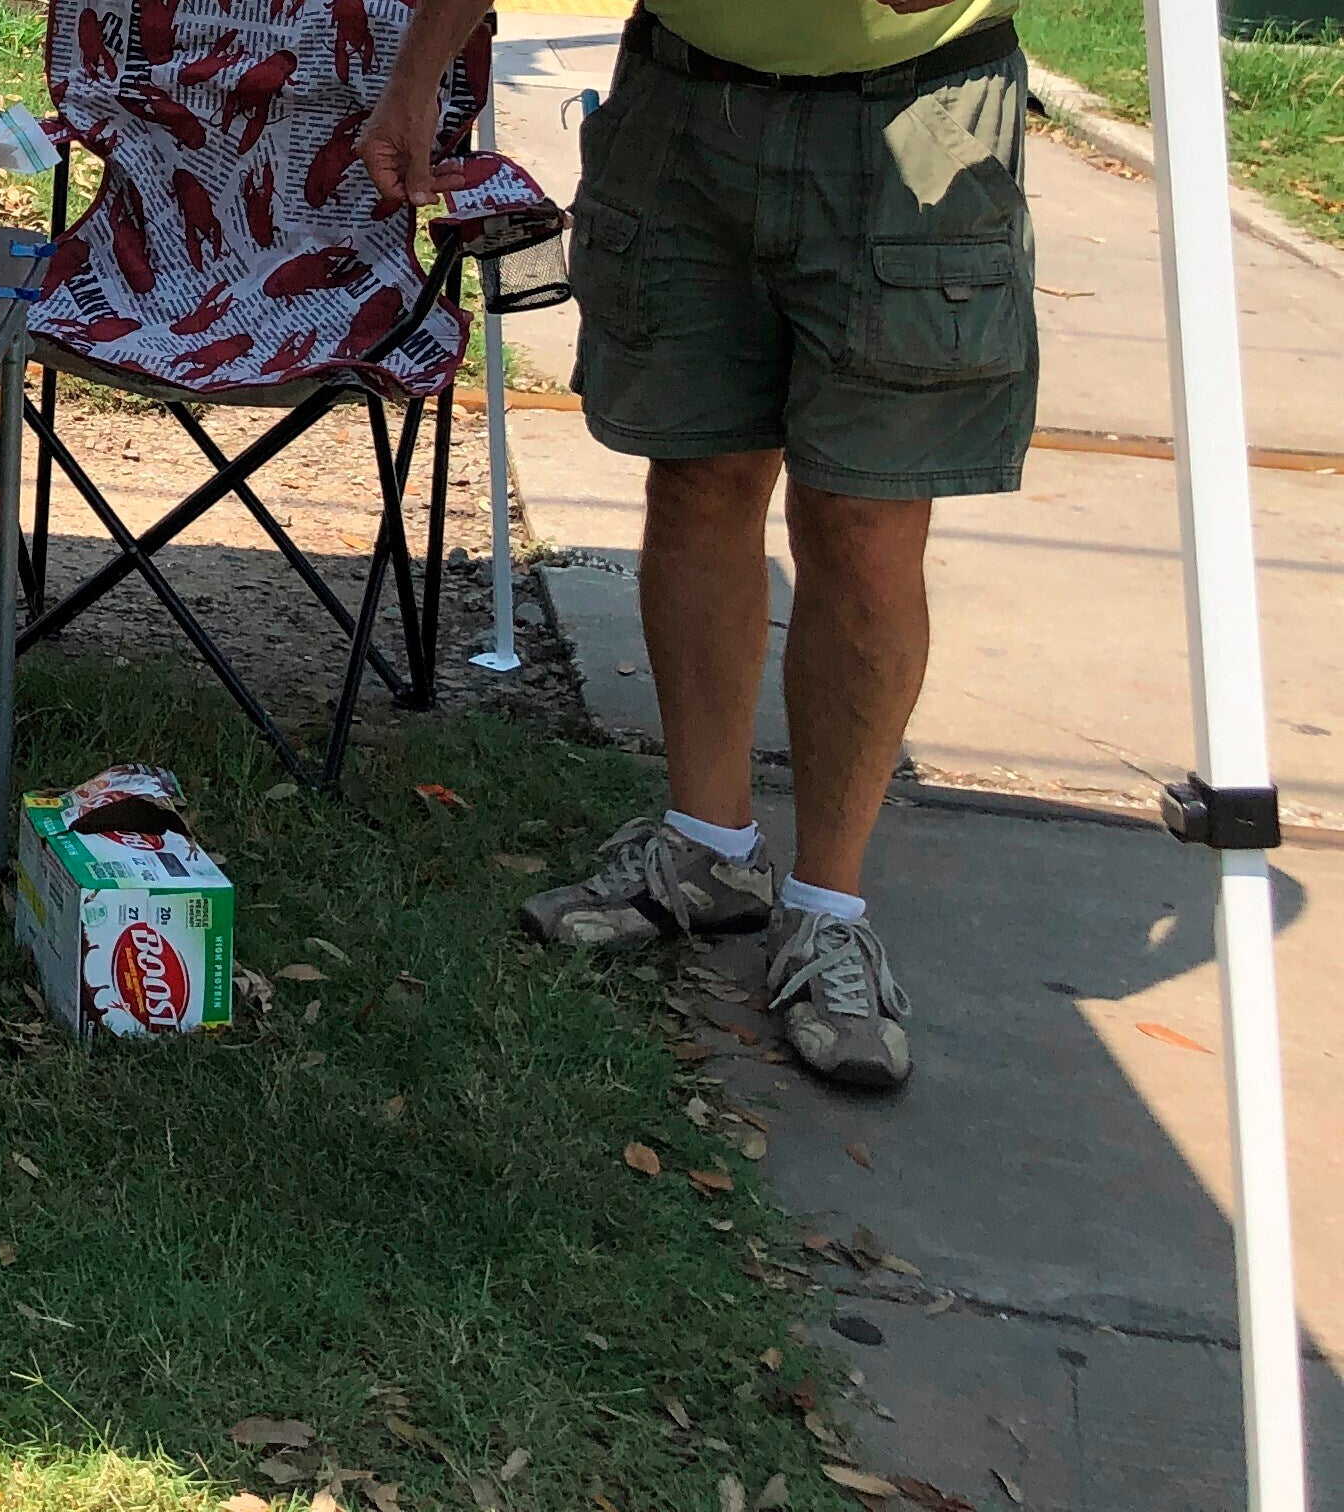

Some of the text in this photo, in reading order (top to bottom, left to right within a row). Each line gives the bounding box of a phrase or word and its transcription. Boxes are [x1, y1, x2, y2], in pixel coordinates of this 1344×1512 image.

[128, 907, 140, 921] 27
[131, 929, 178, 1026] BOOST
[213, 935, 224, 1009] HIGH PROTEIN
